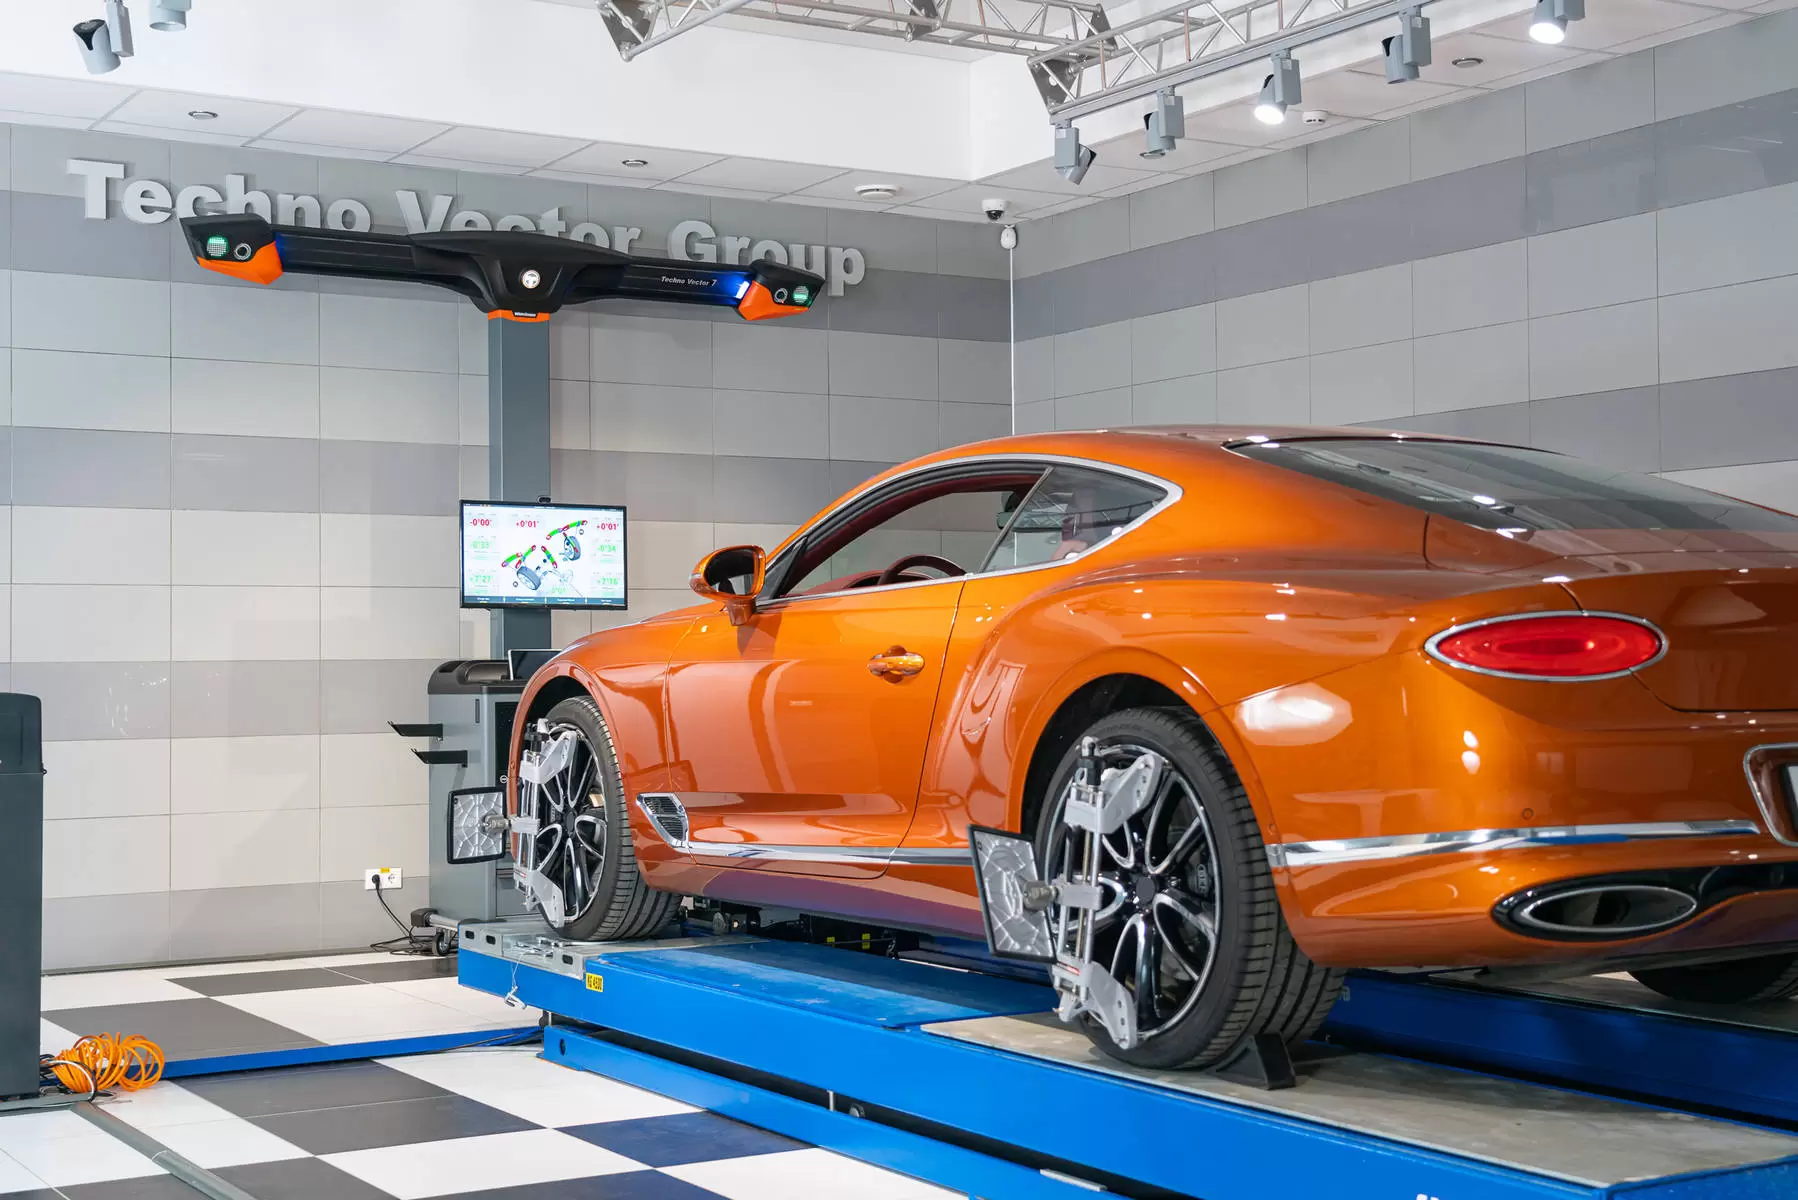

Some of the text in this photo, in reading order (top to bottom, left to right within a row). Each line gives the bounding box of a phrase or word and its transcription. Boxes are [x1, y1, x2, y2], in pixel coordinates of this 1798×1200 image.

[67, 158, 371, 233] Techno
[661, 276, 685, 284] Techno
[687, 278, 709, 286] Vector
